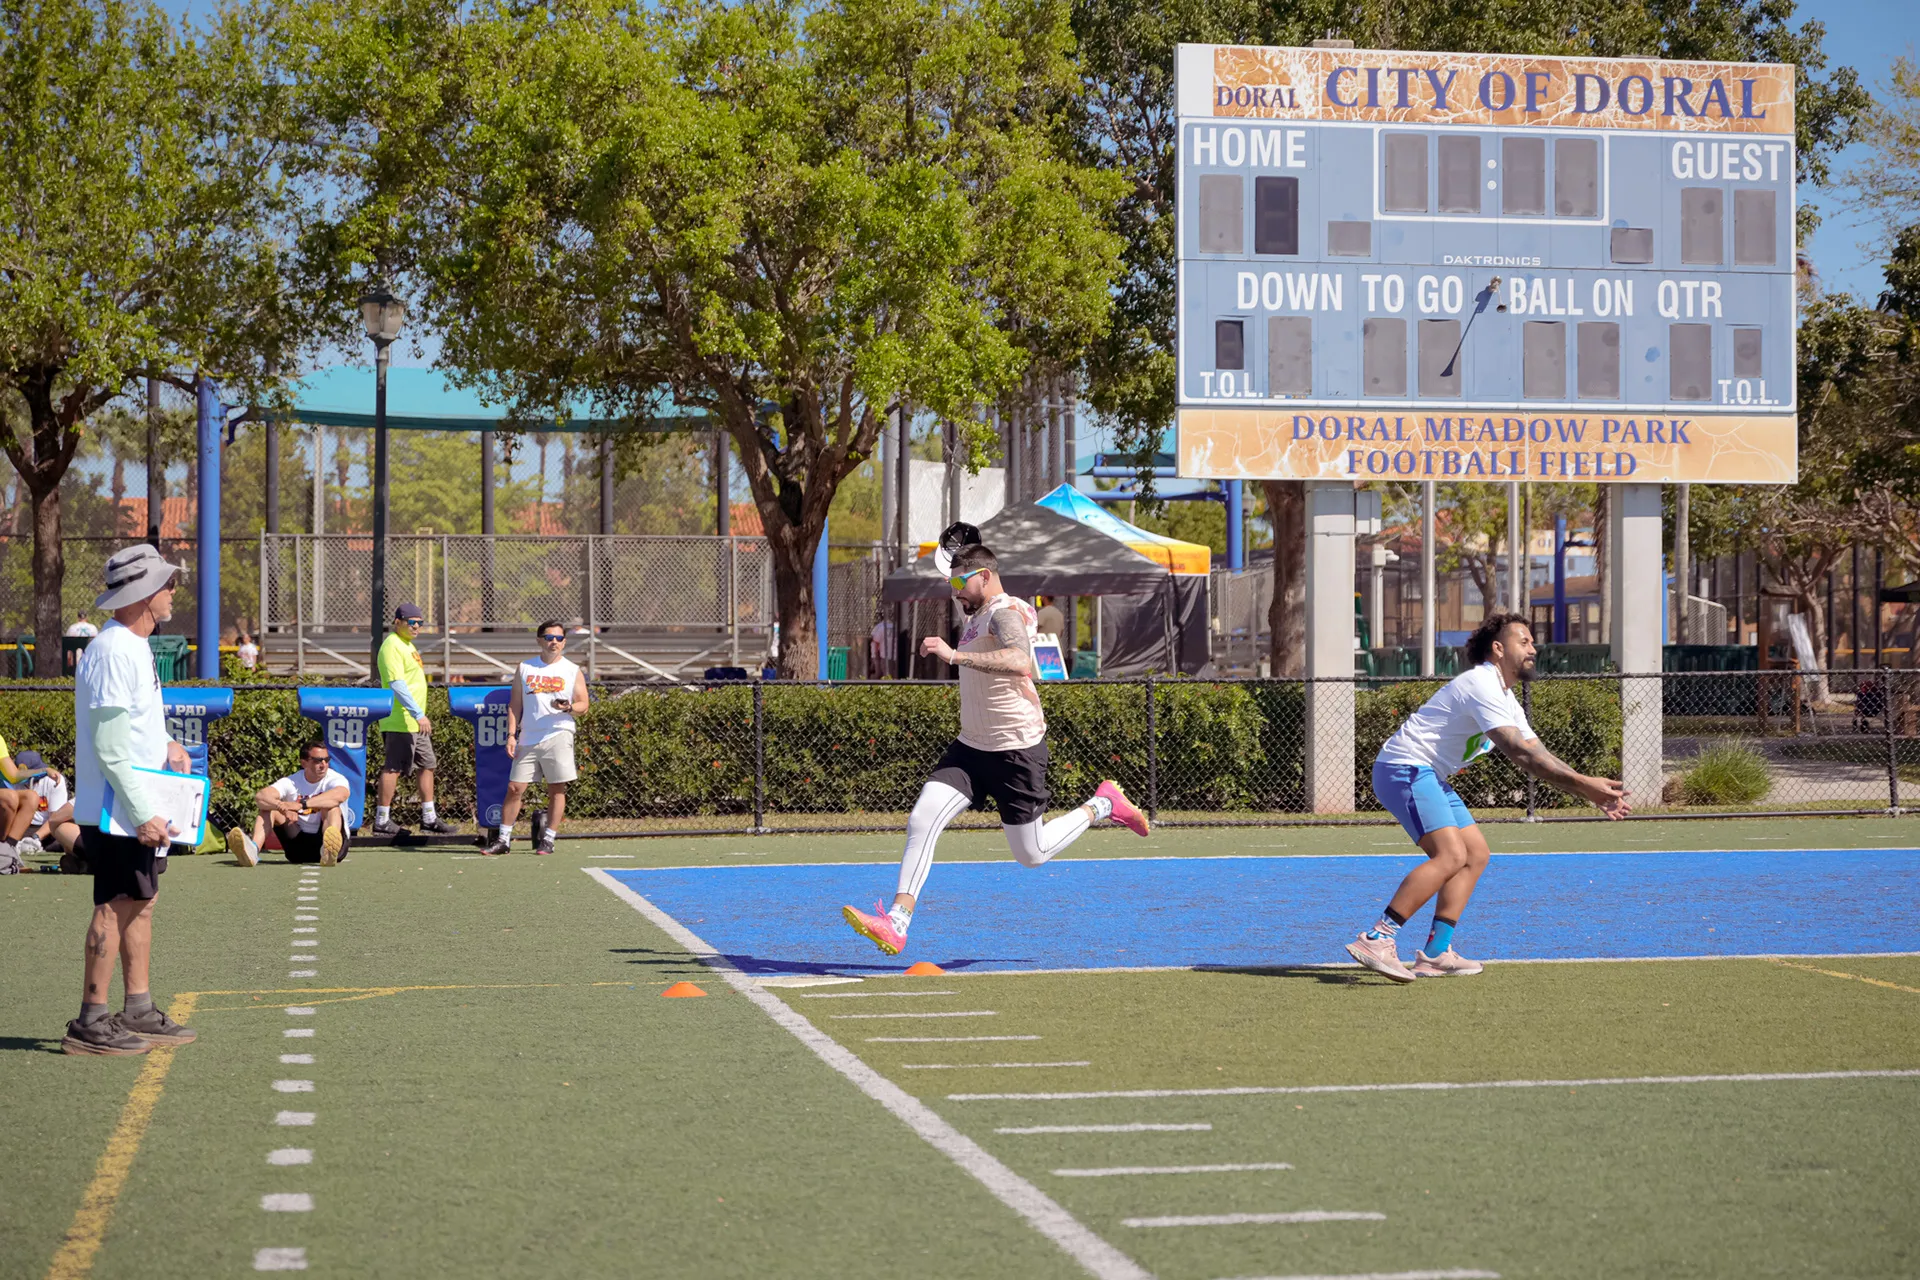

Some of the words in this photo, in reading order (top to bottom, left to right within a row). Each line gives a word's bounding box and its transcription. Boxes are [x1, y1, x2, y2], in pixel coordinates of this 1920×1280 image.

[1216, 85, 1300, 109] DORAL
[1325, 66, 1459, 111] CITY
[1479, 71, 1550, 112] OF
[1572, 73, 1766, 119] DORAL
[1193, 127, 1307, 168] HOME
[1671, 140, 1784, 181] GUEST
[1443, 254, 1542, 266] DAKTRONICS
[1237, 271, 1343, 311] DOWN
[1361, 274, 1404, 313] TO
[1417, 275, 1463, 314] GO
[1509, 277, 1583, 316] BALL
[1593, 278, 1634, 317] ON
[1657, 279, 1723, 320] QTR
[1200, 371, 1263, 398] T.O.L.
[1717, 379, 1779, 405] T.O.L.
[1292, 415, 1411, 441] DORAL
[1424, 417, 1588, 443] MEADOW
[1601, 419, 1691, 444] PARK
[1347, 450, 1526, 475] FOOTBALL
[1540, 451, 1637, 477] FIELD
[163, 704, 172, 715] T
[175, 705, 207, 717] PAD
[324, 705, 335, 717] T
[338, 706, 369, 718] PAD
[474, 703, 485, 715] T
[488, 703, 508, 715] PA
[165, 717, 203, 747] 68
[328, 718, 364, 749] 68
